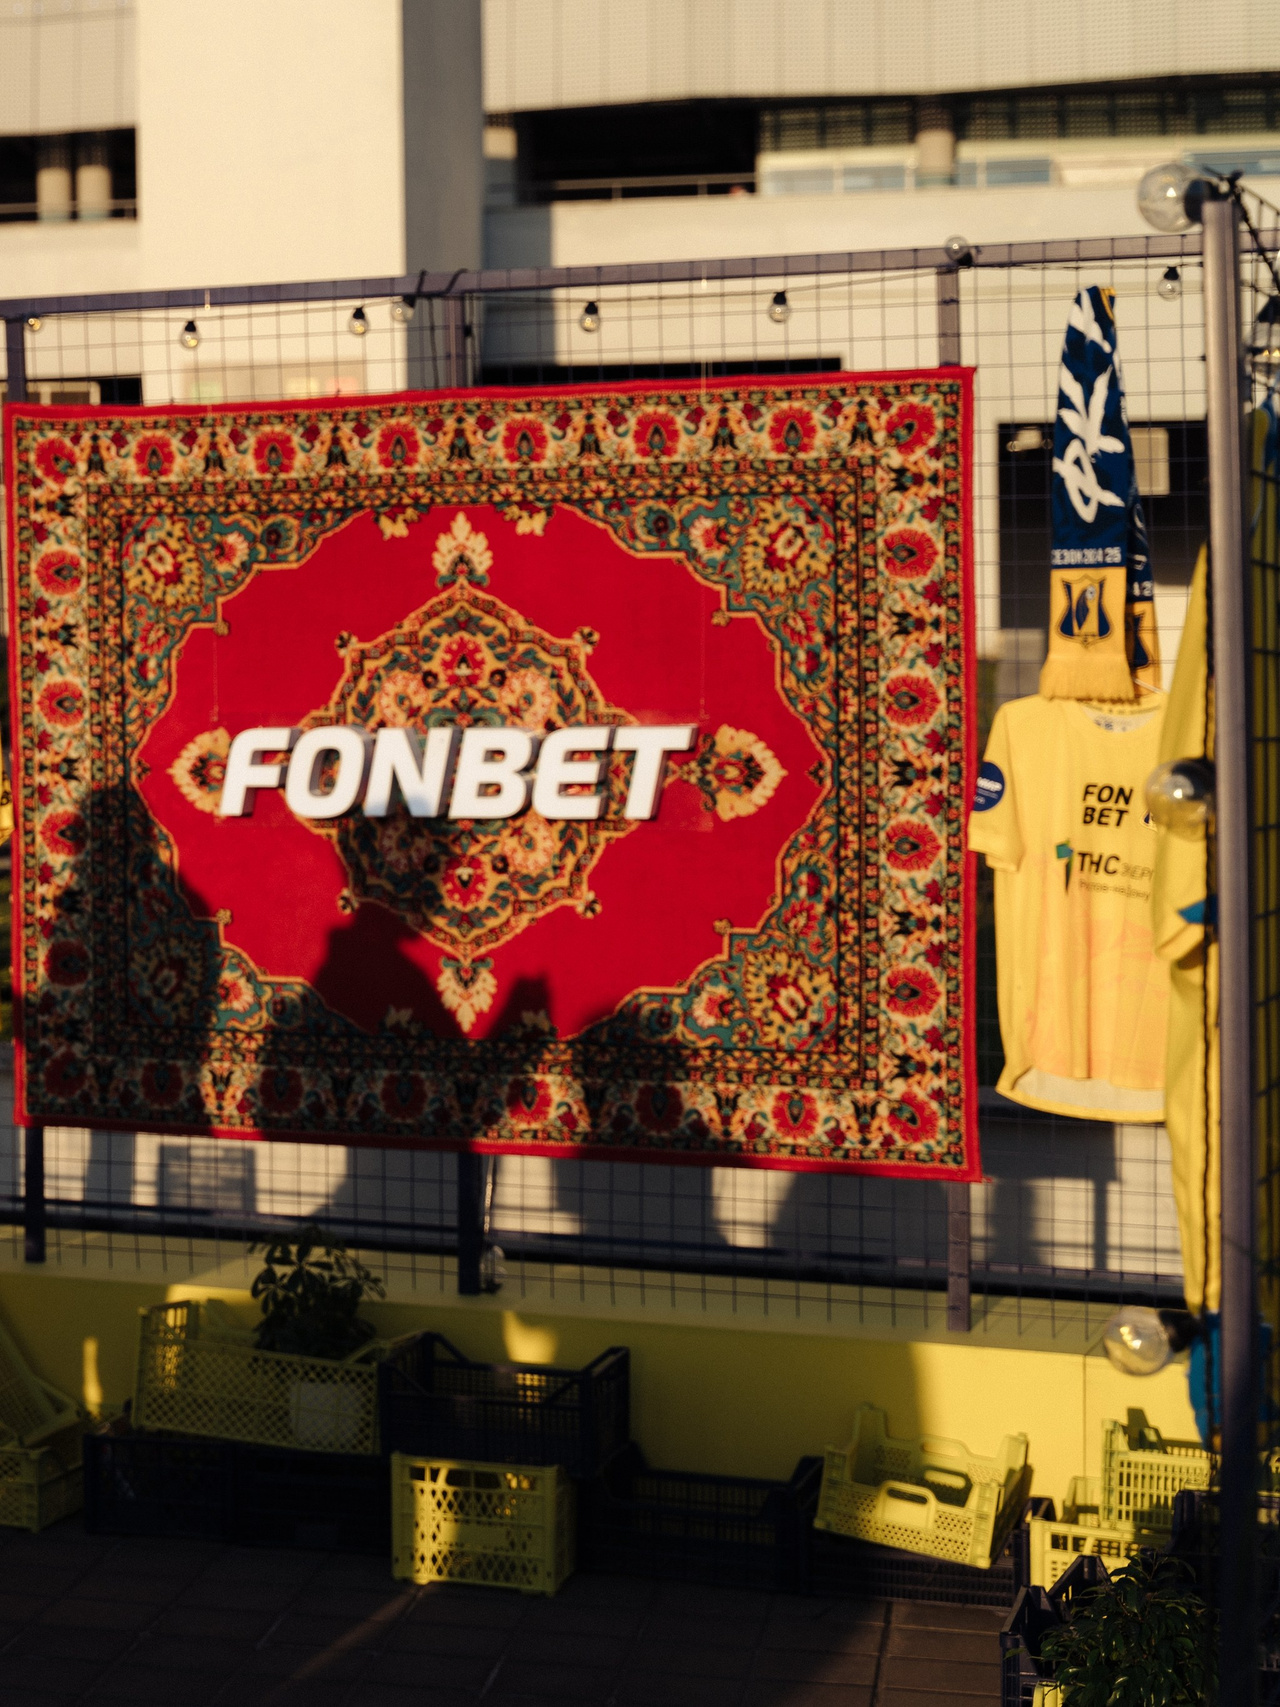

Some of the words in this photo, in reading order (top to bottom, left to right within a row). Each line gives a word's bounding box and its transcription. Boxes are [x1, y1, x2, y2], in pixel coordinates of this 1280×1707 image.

[218, 725, 699, 821] FONBET
[1083, 784, 1134, 806] FON
[1083, 806, 1130, 827] BET
